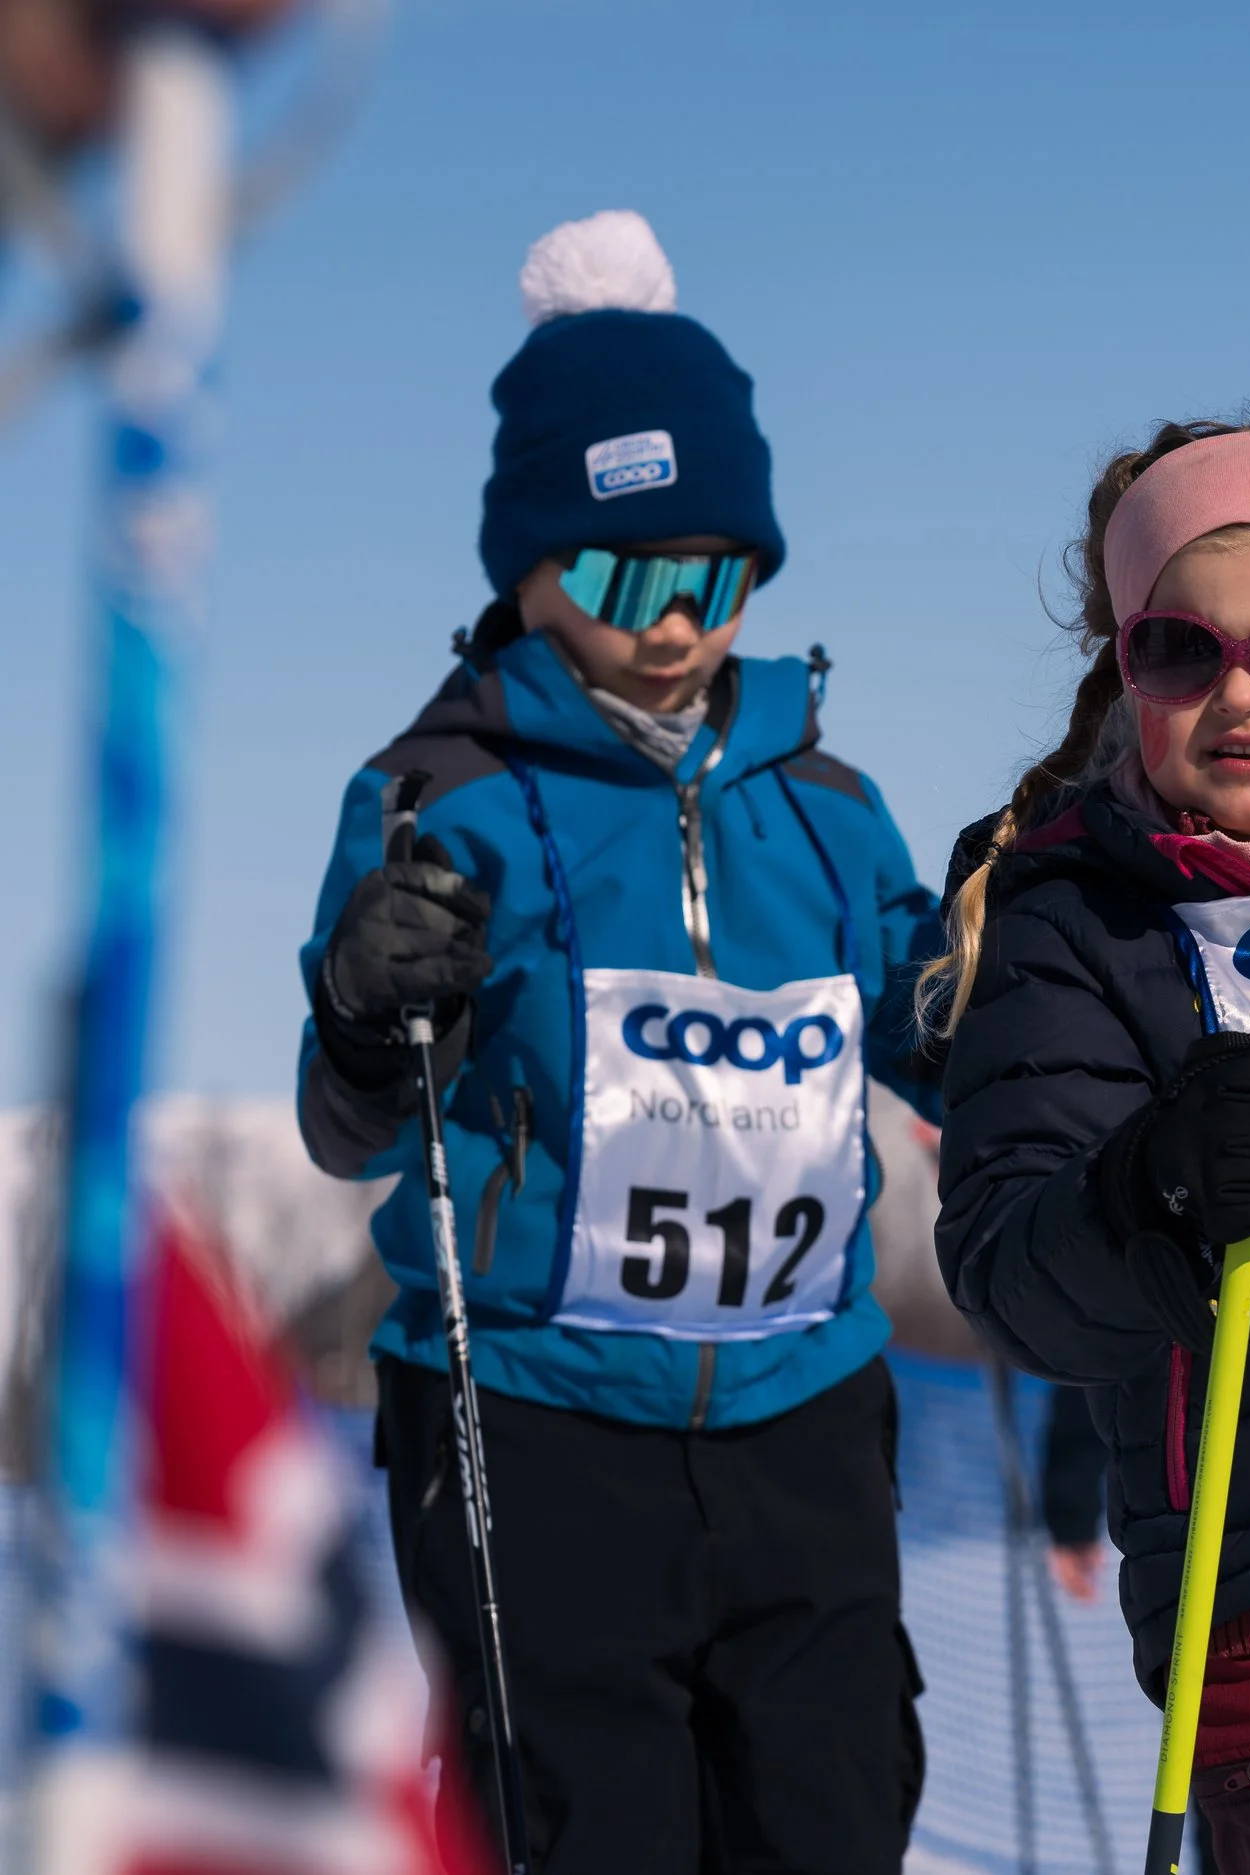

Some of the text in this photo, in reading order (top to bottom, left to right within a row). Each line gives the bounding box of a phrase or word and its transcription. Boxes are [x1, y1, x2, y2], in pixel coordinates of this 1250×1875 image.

[602, 463, 662, 488] coop
[622, 1003, 844, 1085] coop
[620, 1186, 825, 1308] 512
[1161, 1634, 1184, 1762] DIAMOND SPRINT
